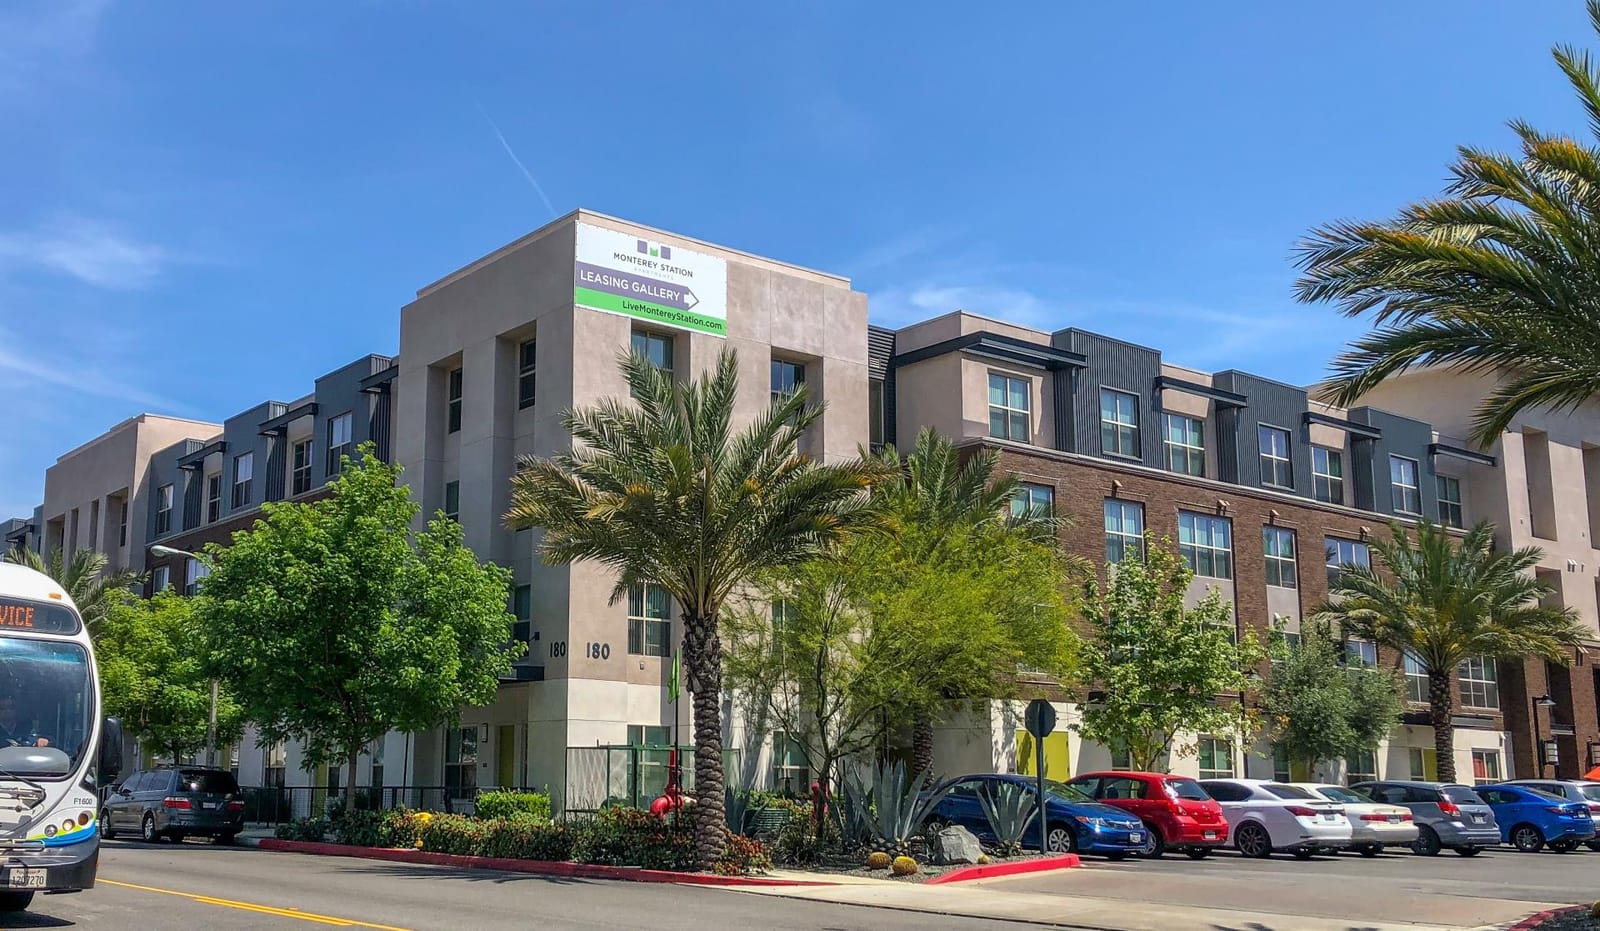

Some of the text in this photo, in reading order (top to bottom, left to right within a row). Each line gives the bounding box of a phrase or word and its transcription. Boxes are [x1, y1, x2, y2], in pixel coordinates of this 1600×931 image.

[614, 252, 693, 277] MONTEREY STATION
[580, 270, 680, 301] LEASING GALLERY
[622, 301, 722, 330] LiveMontereyStation.com
[550, 641, 566, 658] 180
[586, 642, 610, 660] 180
